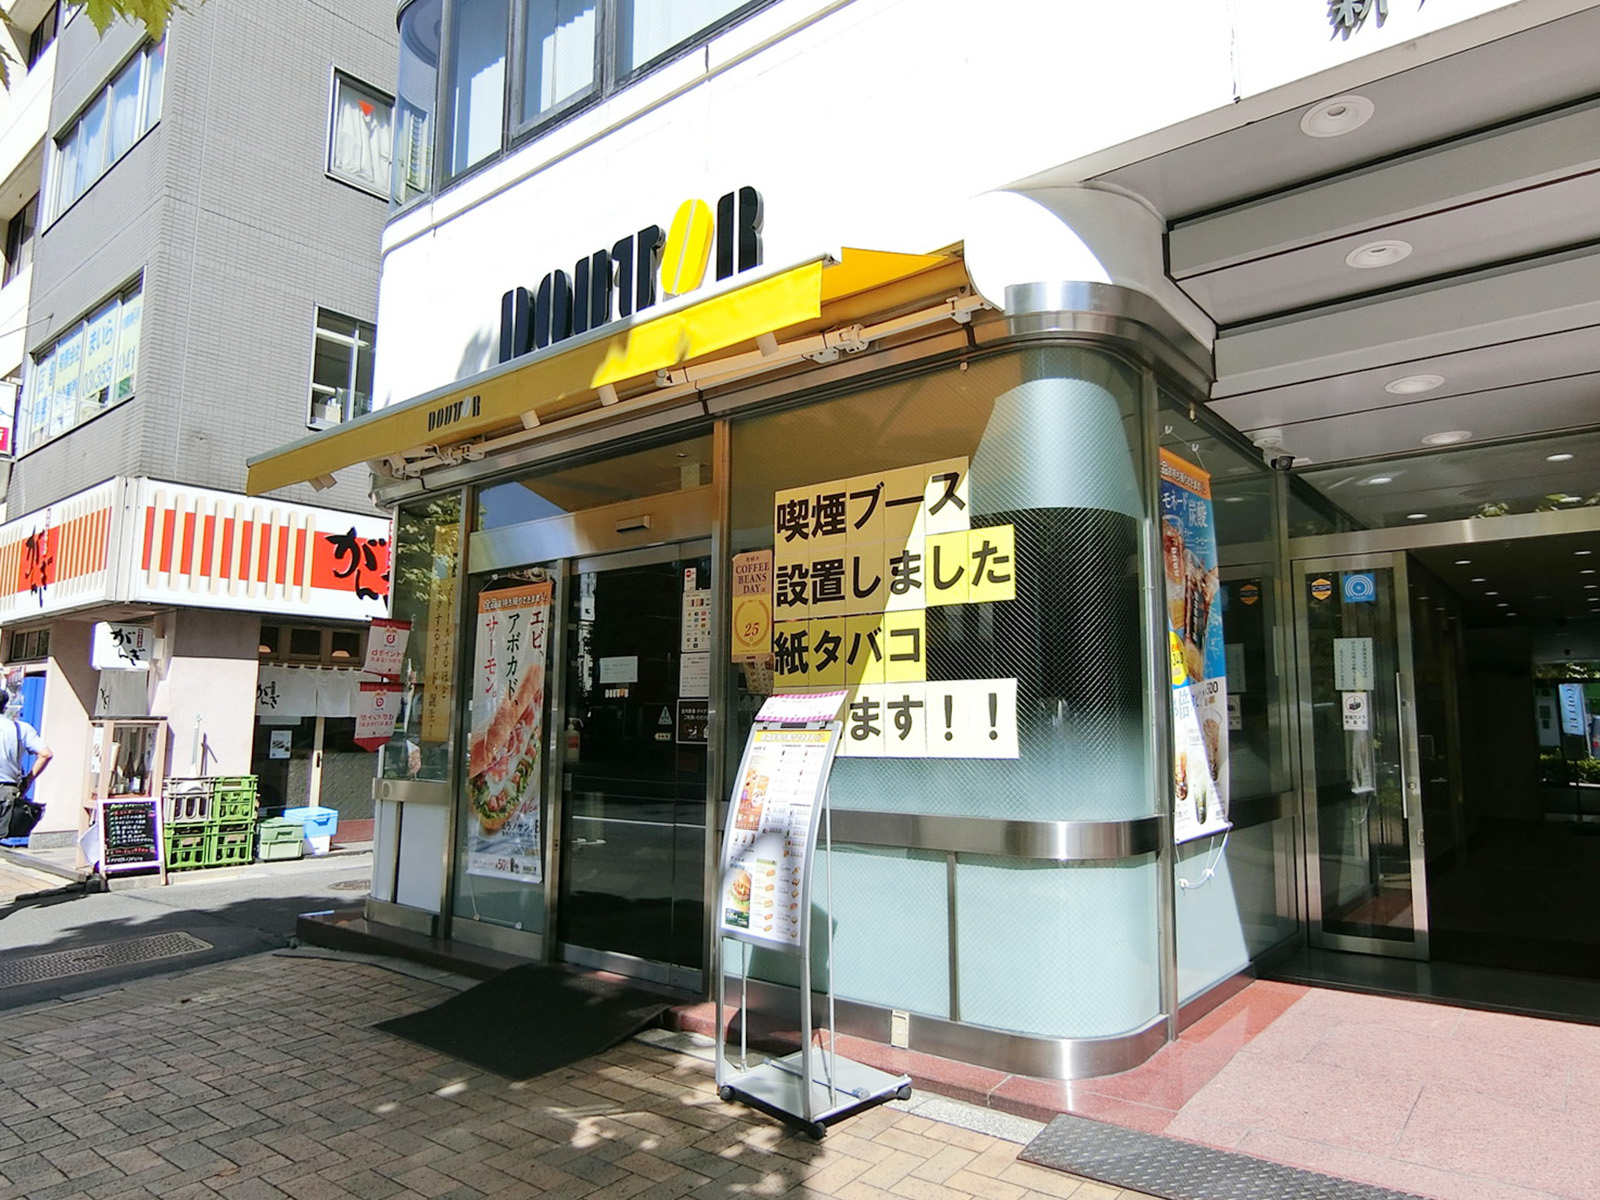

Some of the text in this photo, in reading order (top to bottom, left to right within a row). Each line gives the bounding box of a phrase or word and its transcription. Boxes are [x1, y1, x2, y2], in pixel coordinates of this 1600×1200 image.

[500, 186, 763, 364] DOUTOR
[428, 394, 481, 433] DOUTOR
[776, 471, 966, 543] 喫煙ブース
[1161, 489, 1189, 512] モネード
[735, 562, 770, 575] COFFEE
[738, 572, 767, 584] BEANS
[776, 540, 1011, 608] 設置しました
[743, 584, 761, 594] DAY
[744, 622, 760, 637] 25
[484, 615, 499, 698] サーモン。
[774, 627, 920, 676] 紙タバコ
